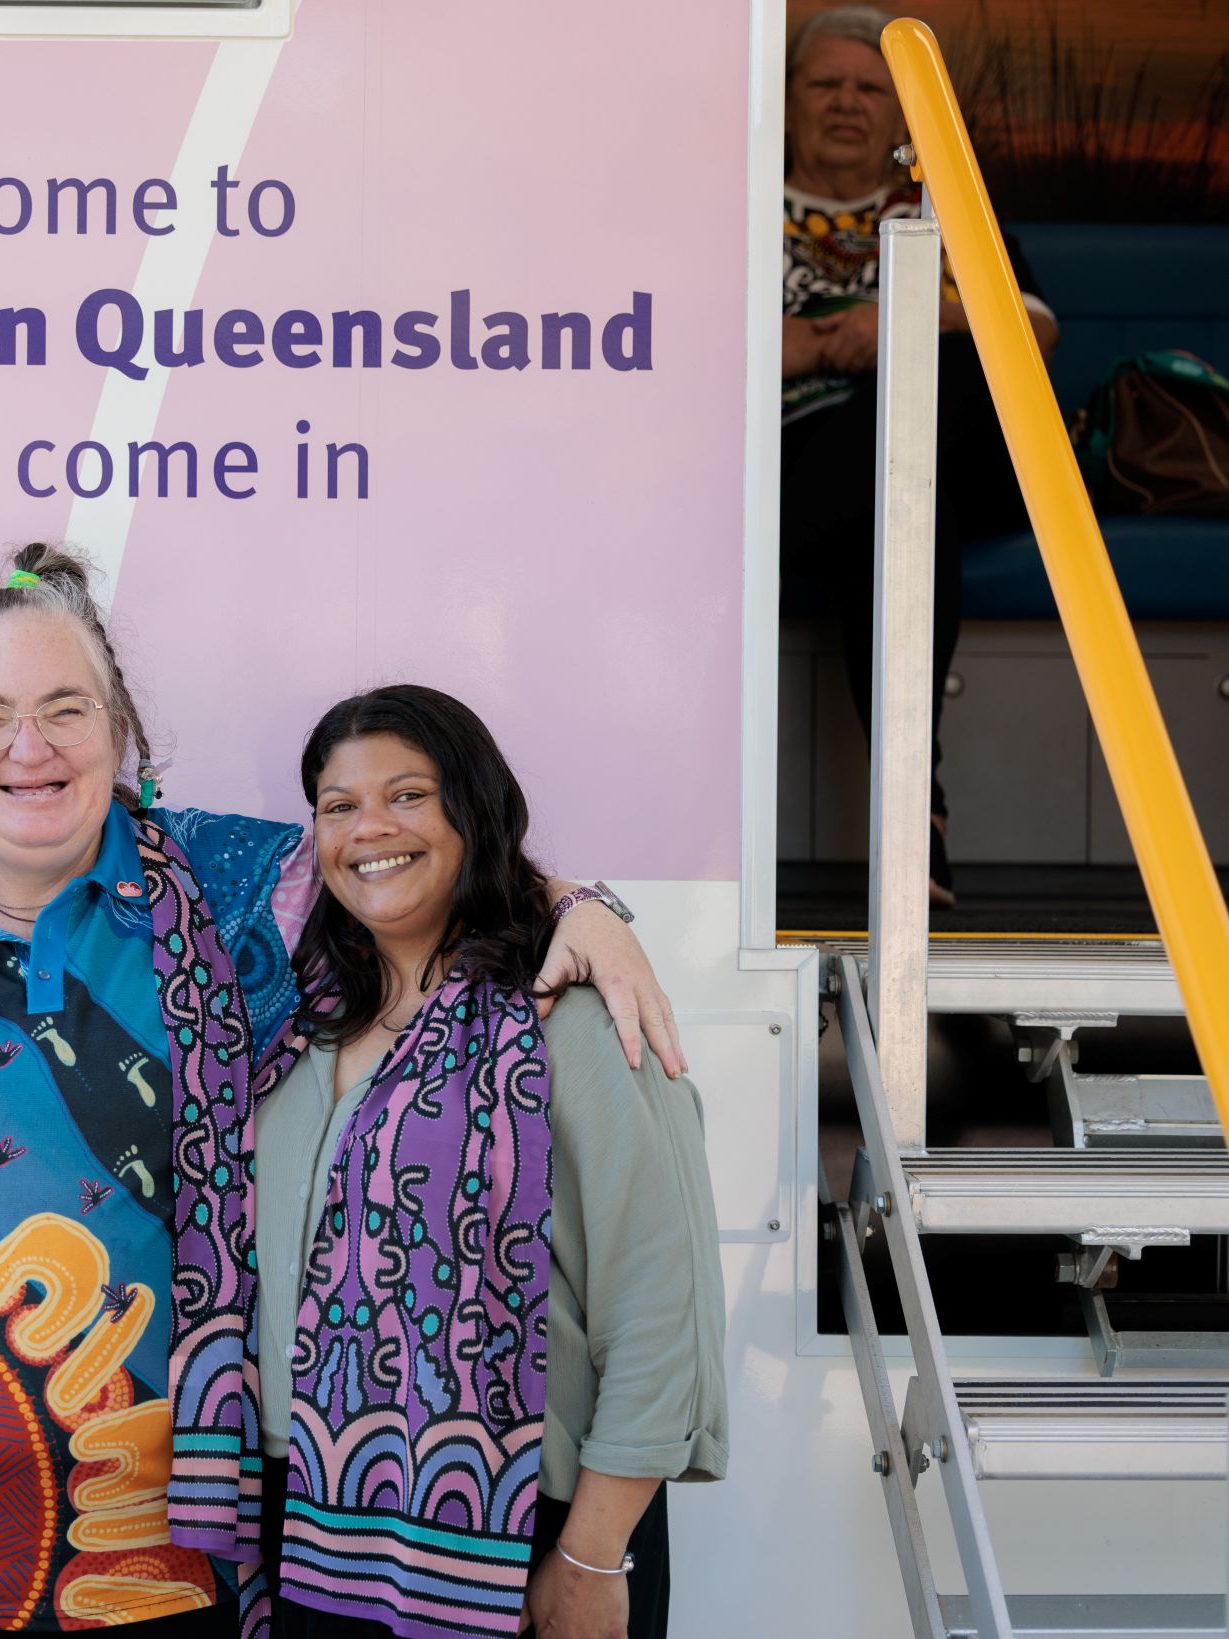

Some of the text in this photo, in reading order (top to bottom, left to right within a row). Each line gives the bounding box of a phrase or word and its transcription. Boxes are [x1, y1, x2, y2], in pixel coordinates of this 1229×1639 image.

[211, 164, 295, 237] to
[75, 288, 653, 380] Queensland
[17, 439, 258, 499] come
[295, 419, 369, 499] in
